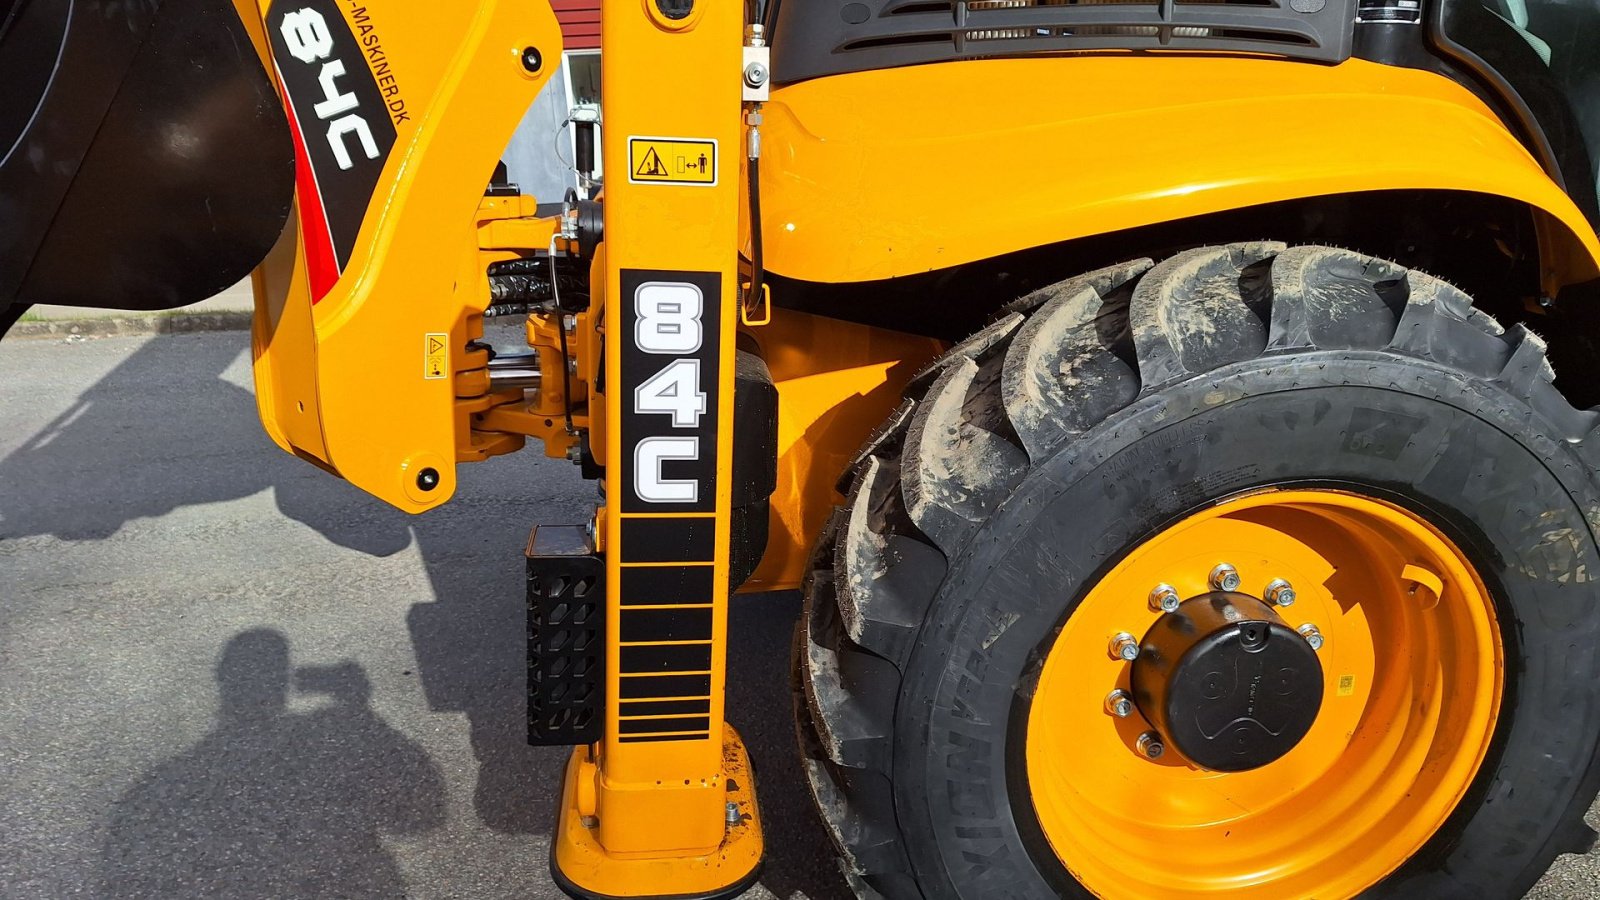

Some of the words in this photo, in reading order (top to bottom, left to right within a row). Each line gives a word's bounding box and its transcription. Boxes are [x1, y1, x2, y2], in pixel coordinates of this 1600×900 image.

[280, 7, 380, 171] 84C
[346, 0, 411, 125] -MASKINER.DK
[634, 281, 707, 503] 84C
